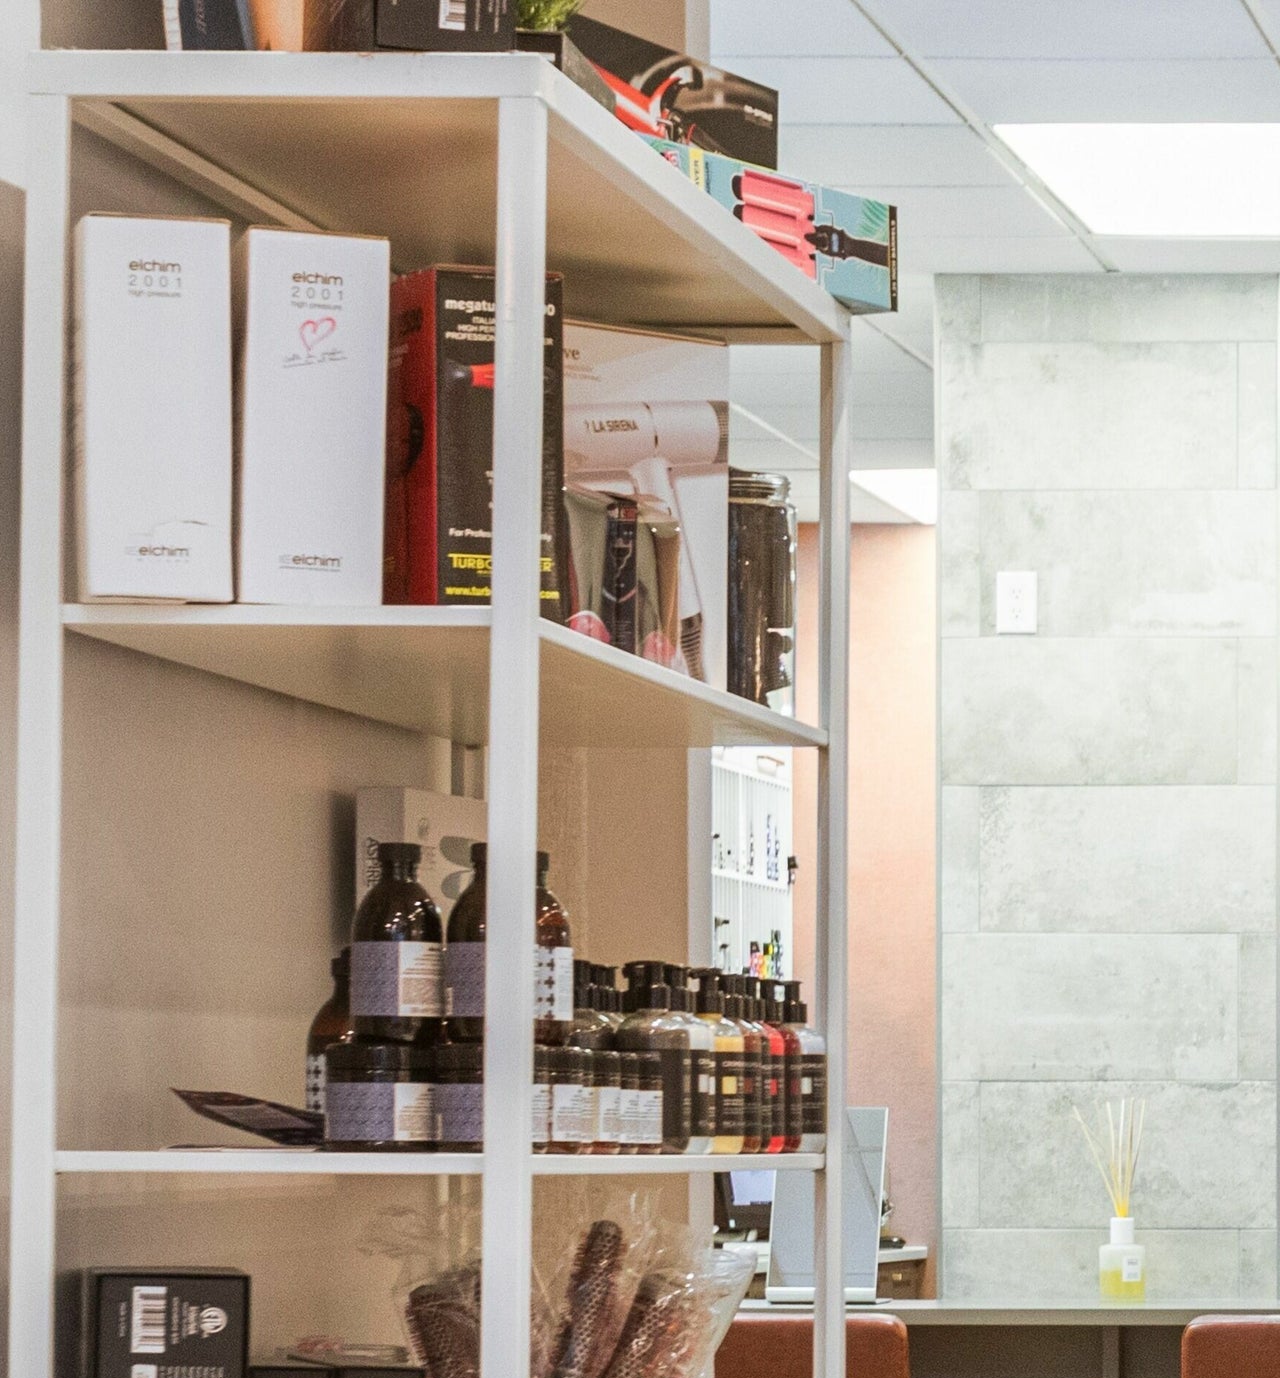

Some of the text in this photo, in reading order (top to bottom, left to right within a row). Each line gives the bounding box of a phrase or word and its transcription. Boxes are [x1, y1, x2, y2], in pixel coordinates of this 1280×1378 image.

[129, 259, 181, 272] elchim
[129, 274, 181, 288] 2001
[292, 271, 343, 286] elchim
[291, 286, 343, 301] 2001
[445, 299, 496, 313] megatu
[138, 545, 189, 557] elchim
[292, 554, 341, 568] elchim
